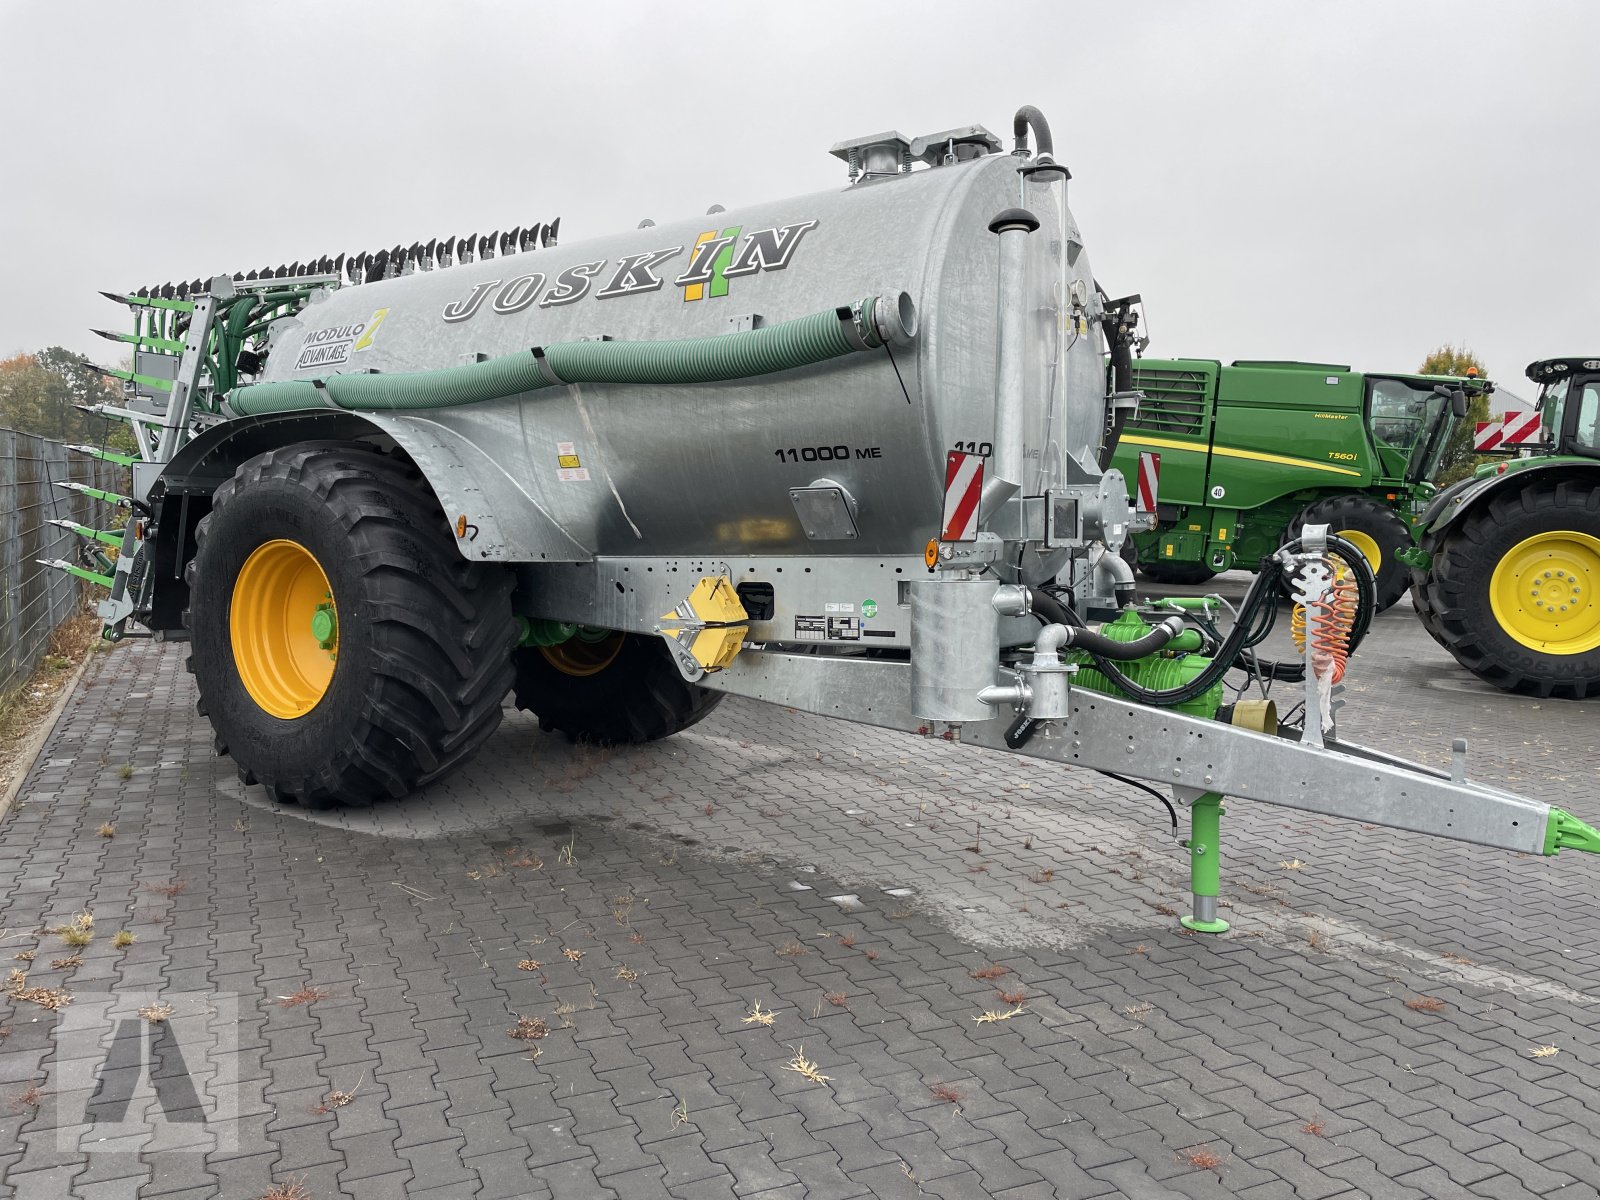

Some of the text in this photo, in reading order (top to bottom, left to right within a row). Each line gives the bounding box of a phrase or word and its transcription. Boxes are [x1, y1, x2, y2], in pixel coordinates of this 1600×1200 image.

[441, 219, 819, 323] JOSKIN
[303, 307, 388, 350] MODULO 2
[294, 344, 349, 369] ADVANTAGE
[774, 445, 882, 463] 11000 ME
[1328, 452, 1358, 461] T560i
[1213, 488, 1223, 497] 40
